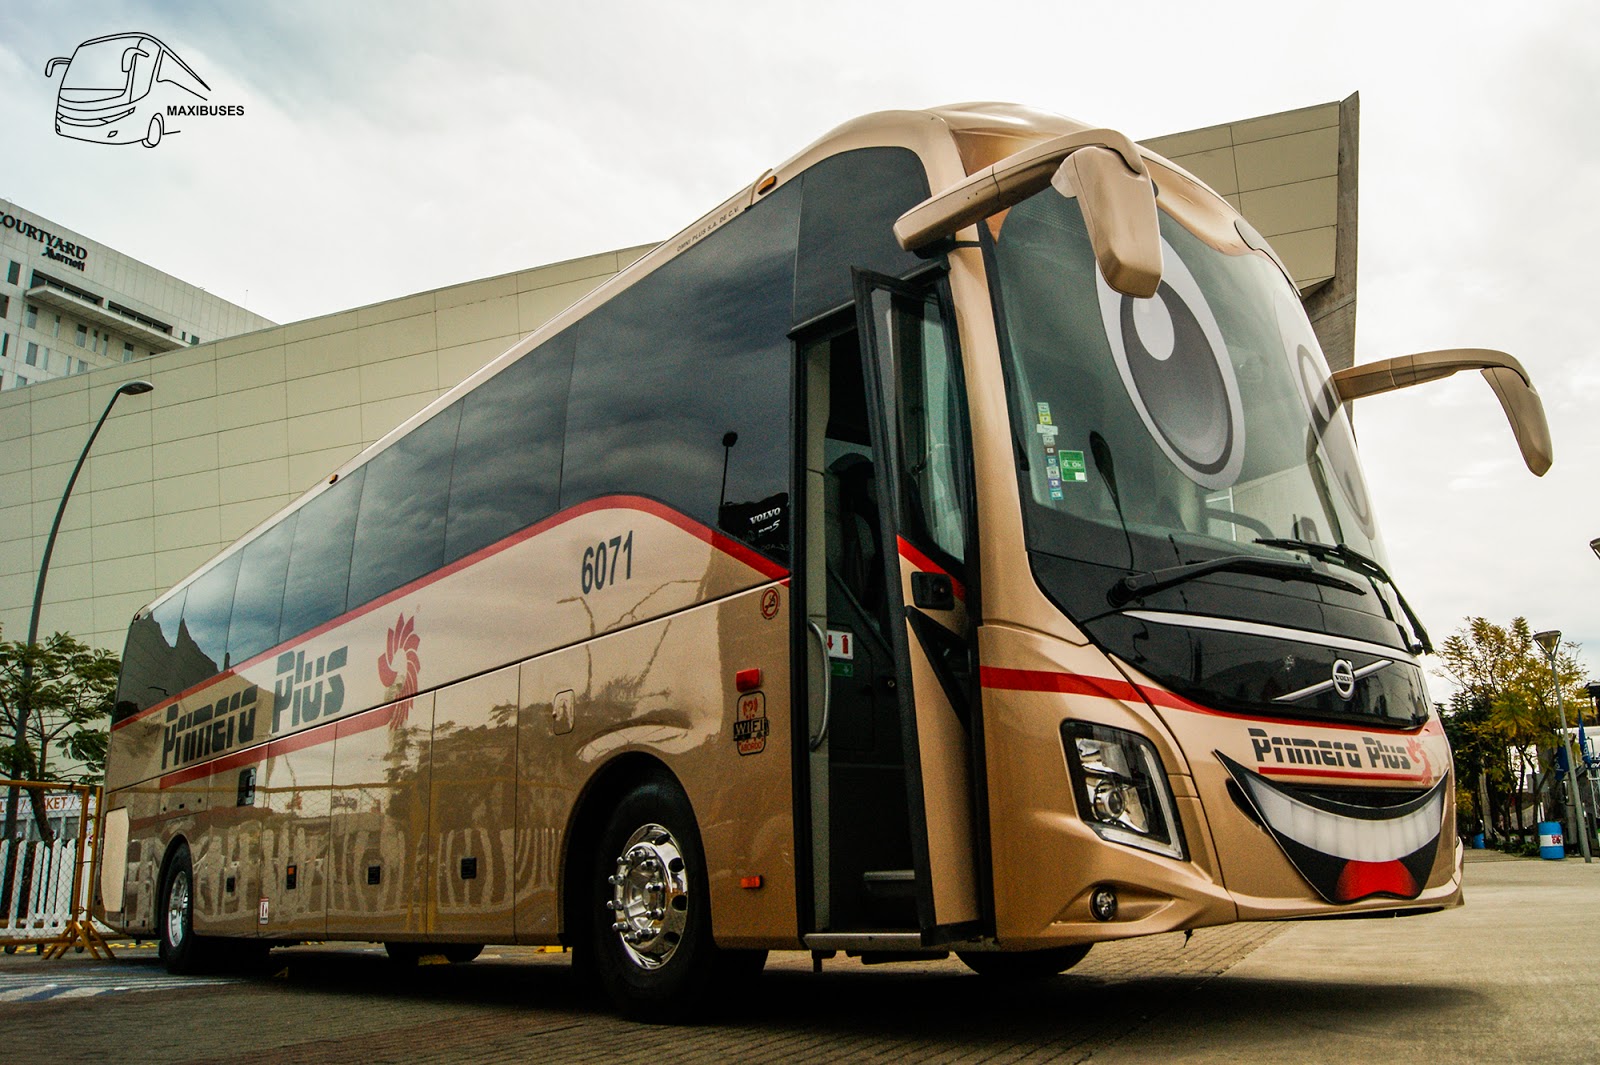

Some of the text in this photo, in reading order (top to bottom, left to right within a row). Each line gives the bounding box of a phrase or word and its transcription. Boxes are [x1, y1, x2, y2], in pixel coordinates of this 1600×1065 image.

[750, 507, 781, 524] VOLVO
[581, 529, 633, 595] 6071
[161, 645, 348, 770] Primera Plus
[1248, 728, 1411, 769] Primera Plus
